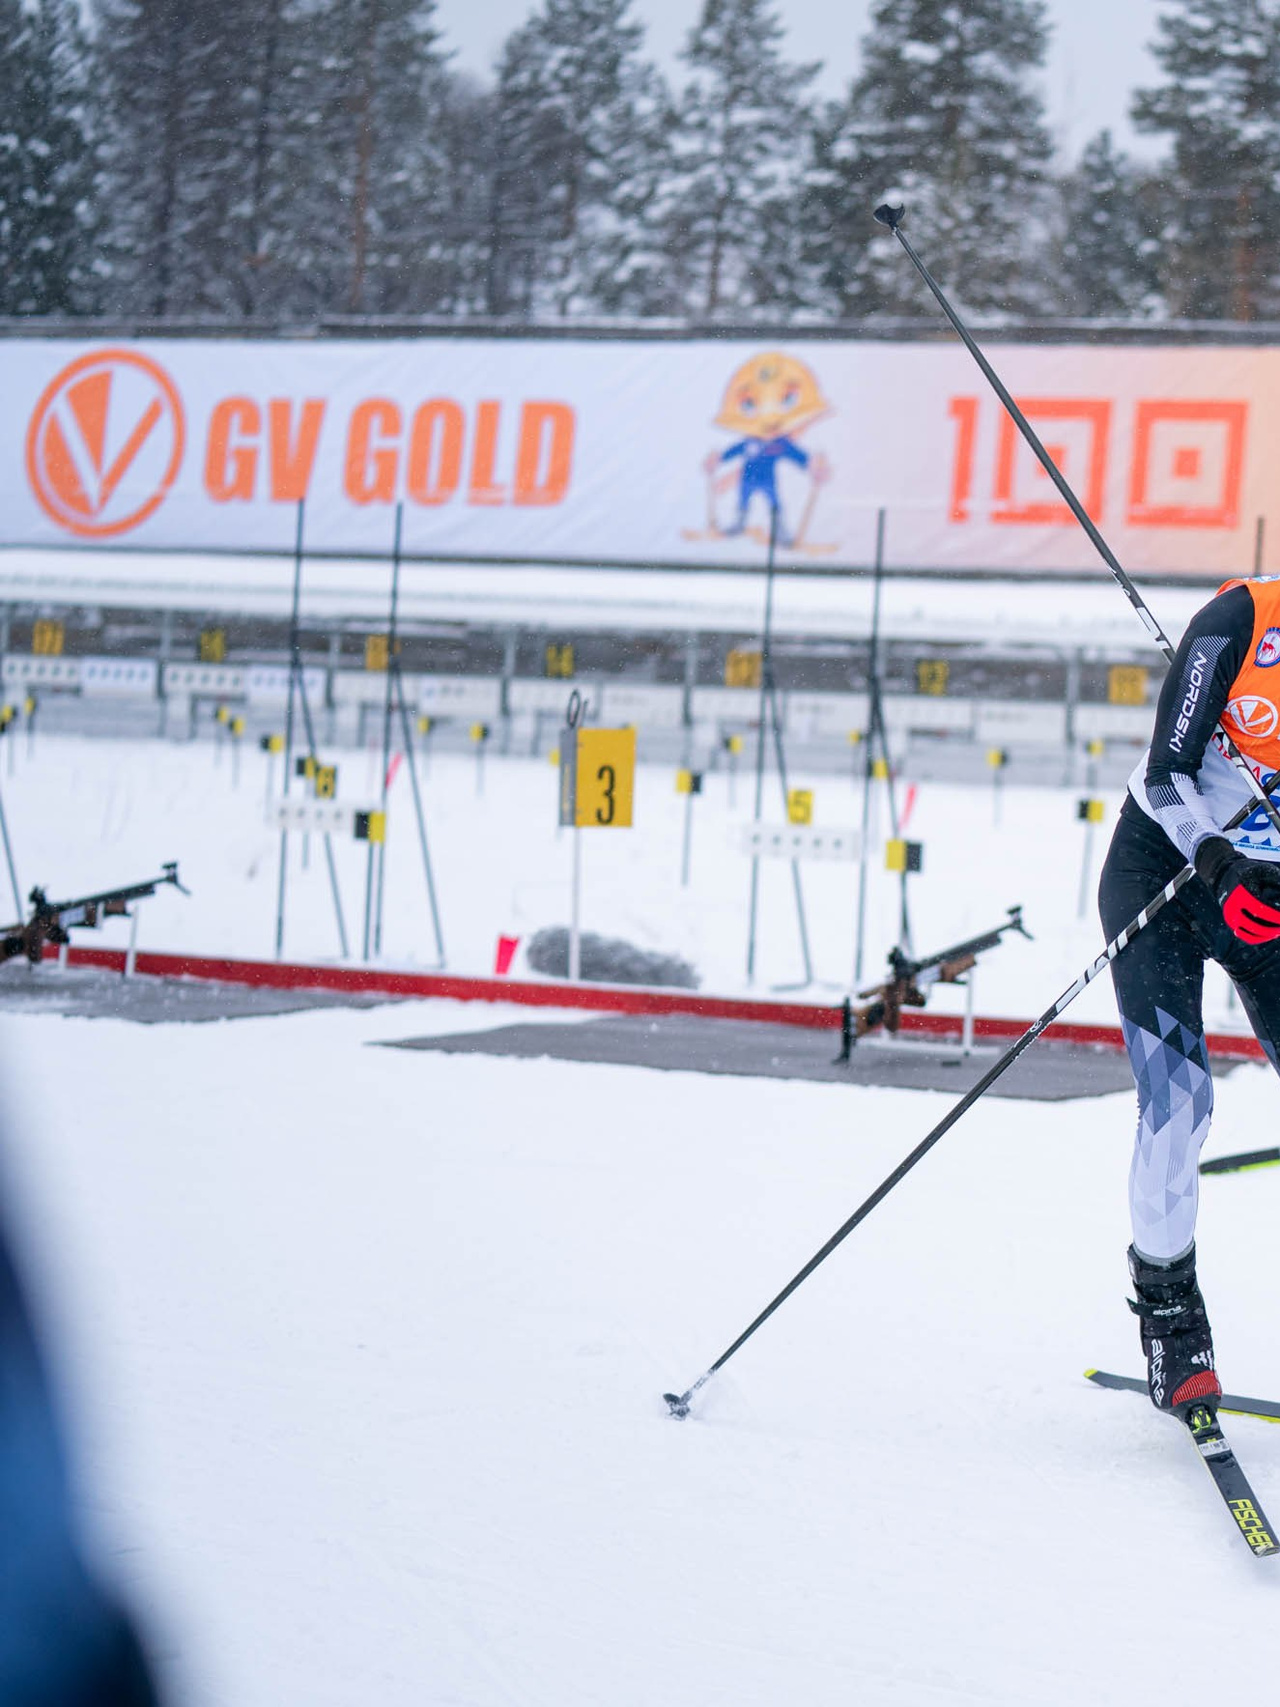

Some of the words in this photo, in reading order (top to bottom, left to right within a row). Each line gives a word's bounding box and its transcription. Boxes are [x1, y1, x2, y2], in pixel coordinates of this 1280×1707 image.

[204, 394, 327, 503] GV
[344, 396, 576, 506] GOLD
[948, 397, 1249, 528] 100
[1169, 652, 1207, 753] NORDSKI
[596, 764, 616, 825] 3
[1150, 1338, 1166, 1407] alpina
